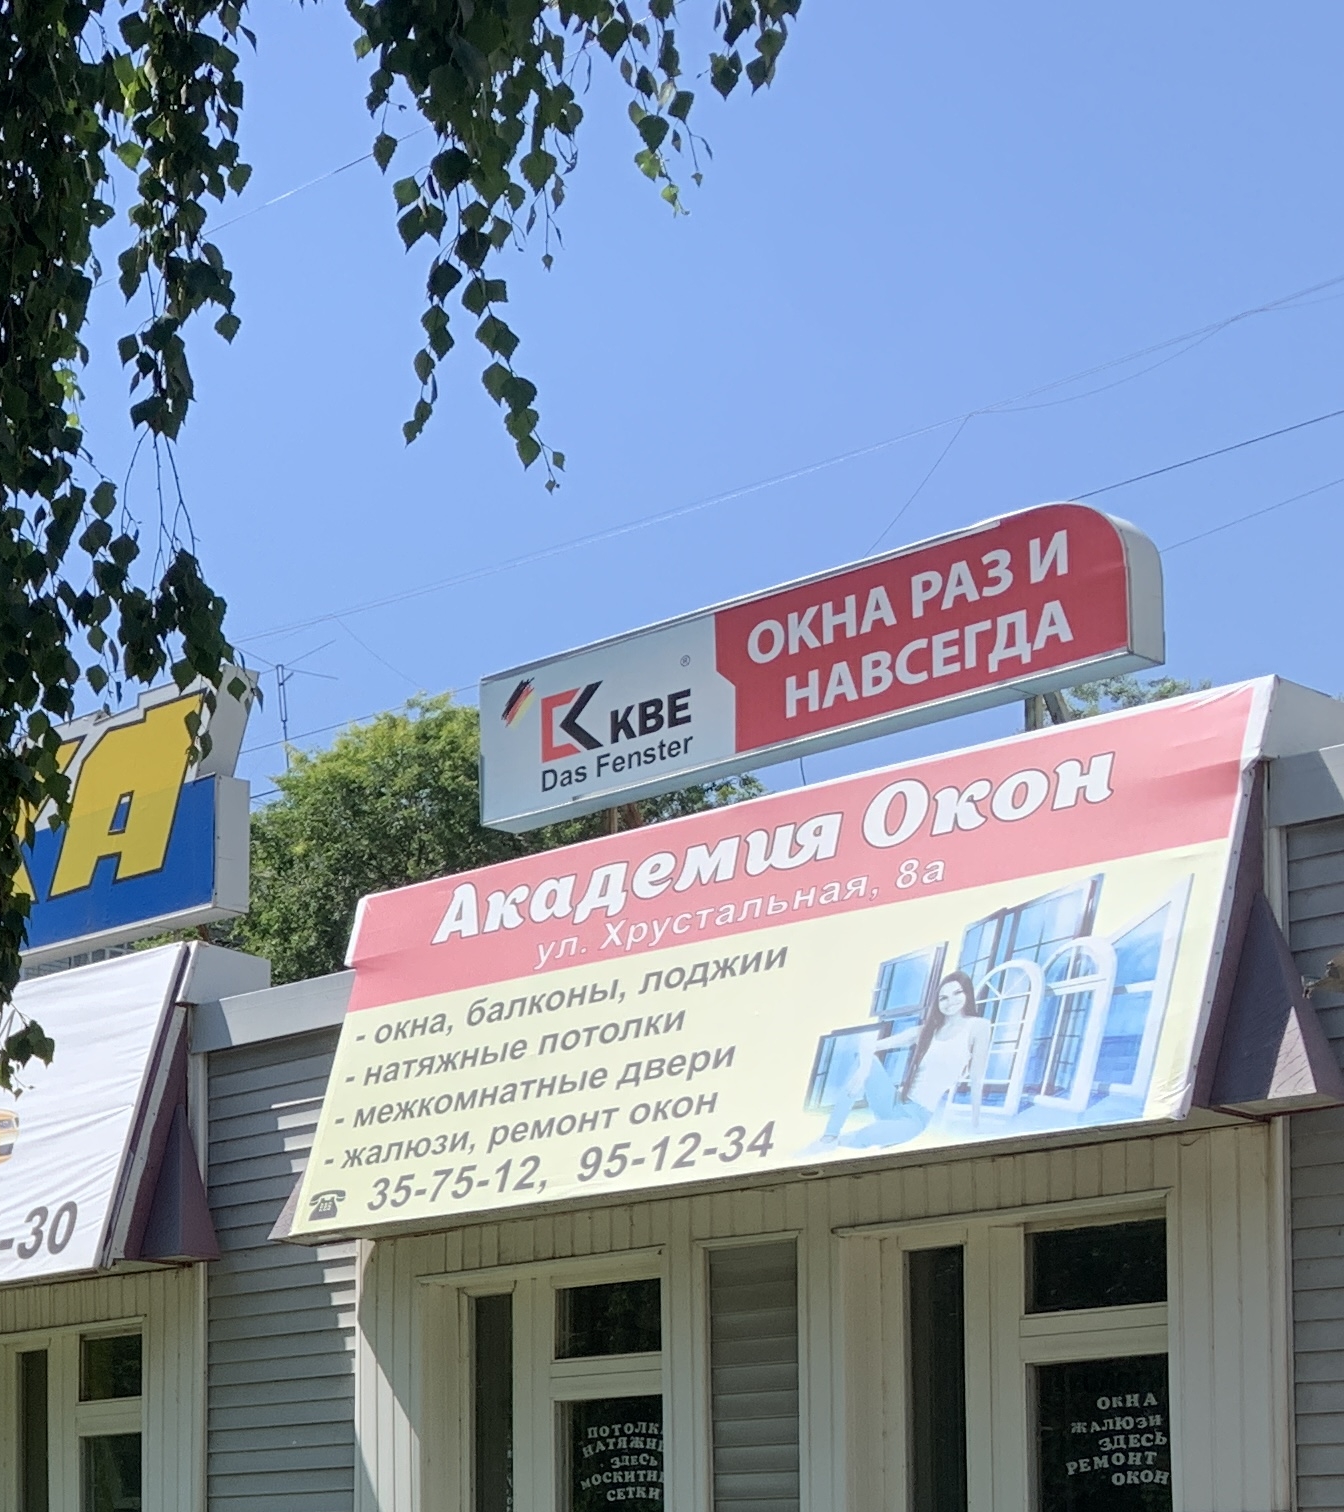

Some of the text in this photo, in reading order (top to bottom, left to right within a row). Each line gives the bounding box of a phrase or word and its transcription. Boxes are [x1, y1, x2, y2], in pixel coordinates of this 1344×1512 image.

[747, 530, 1068, 664] ОКНА РАЗ И
[785, 600, 1074, 718] НАВСЕГДА
[610, 688, 691, 745] KBE
[541, 736, 693, 792] Das Fenster
[431, 751, 1116, 945] Академия Окон
[533, 857, 945, 970] ул. Хрустальная, 8а
[374, 946, 788, 1044] окна, балконы, лоджии
[363, 1010, 686, 1086] натяжные потолки
[353, 1045, 736, 1128] межкомнатные двери
[341, 1092, 718, 1169] жалюзи, ремонт окон
[367, 1120, 775, 1211] 35-75-12, 95-12-34
[1071, 1414, 1161, 1433] ЖАЛЮЗИ
[1096, 1392, 1158, 1410] ОКНА
[587, 1421, 664, 1439] ПОТОЛК
[1098, 1431, 1168, 1451] ЗДЕСЬ
[610, 1453, 658, 1468] ЗДЕСЬ
[1065, 1451, 1157, 1475] РЕМОНТ
[1111, 1469, 1170, 1485] ОКОН
[606, 1486, 661, 1502] СЕТКИ
